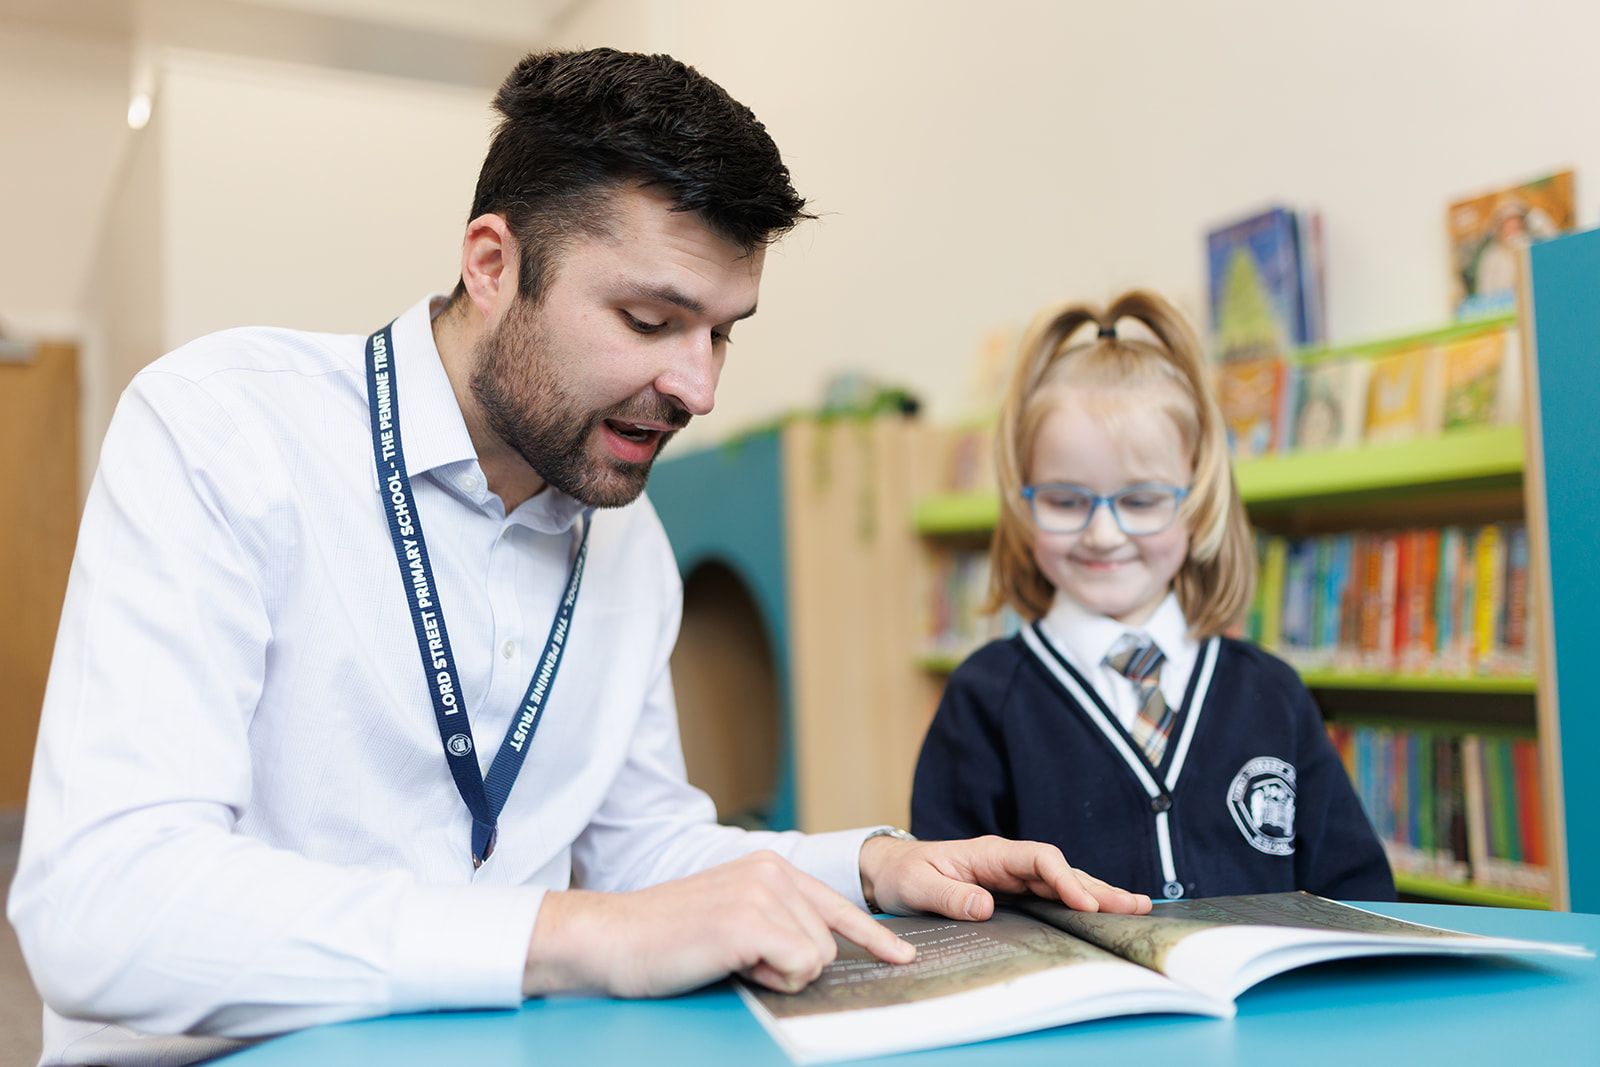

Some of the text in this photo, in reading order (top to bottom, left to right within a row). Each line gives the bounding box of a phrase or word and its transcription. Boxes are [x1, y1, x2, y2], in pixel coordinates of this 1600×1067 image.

[373, 333, 388, 372] TRUST
[381, 430, 396, 462] THE
[387, 470, 415, 537] SCHOOL
[403, 539, 433, 609] PRIMARY
[421, 611, 448, 670] STREET
[553, 617, 568, 646] THE
[437, 671, 459, 716] LORD
[530, 643, 561, 705] PENNINE
[510, 705, 538, 752] TRUST
